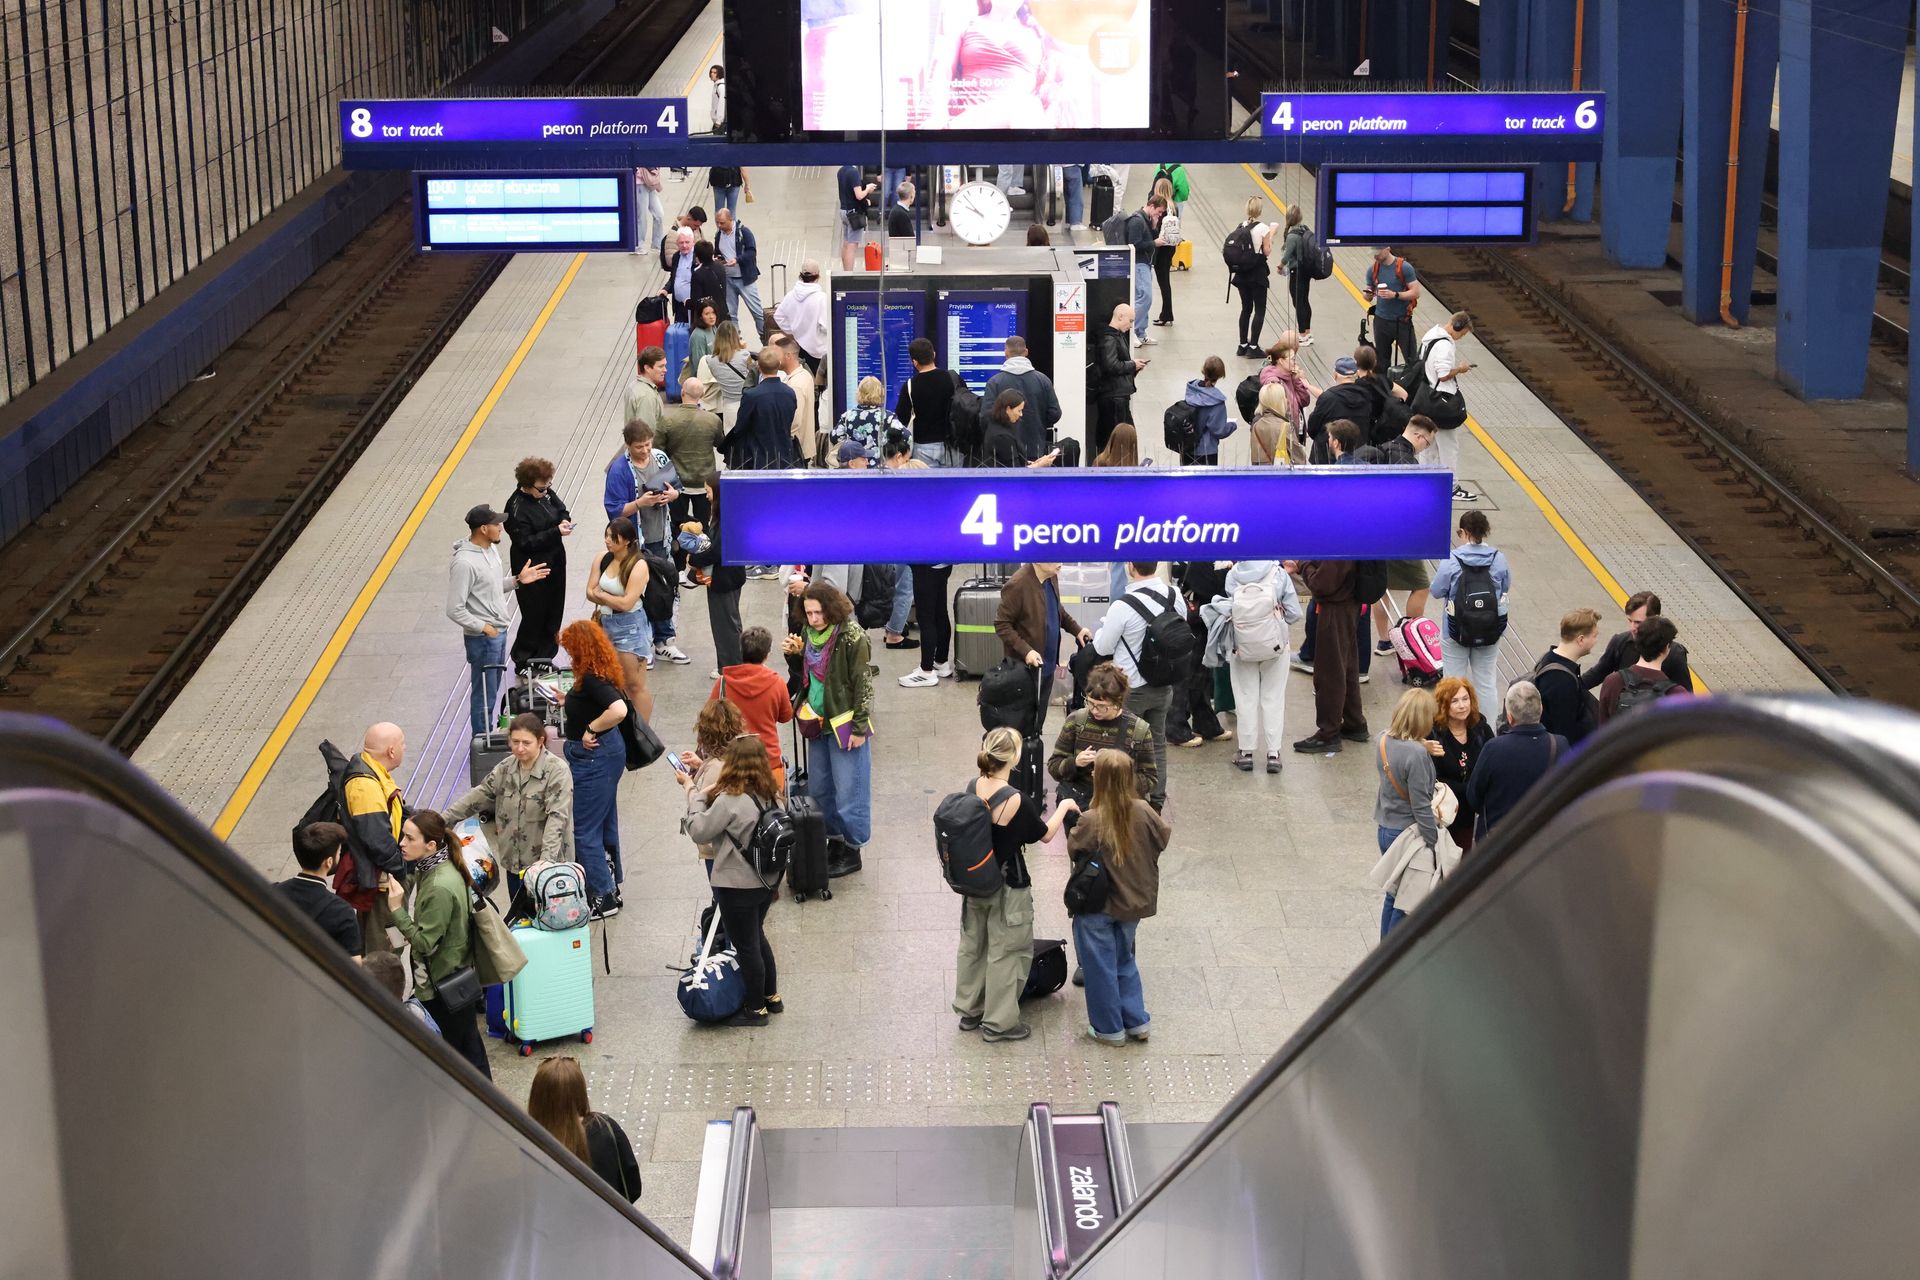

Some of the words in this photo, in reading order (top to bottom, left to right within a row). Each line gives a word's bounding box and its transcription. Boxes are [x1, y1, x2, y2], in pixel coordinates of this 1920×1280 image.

[351, 108, 373, 138] 8
[382, 124, 403, 137] tor
[409, 122, 444, 137] track
[543, 124, 584, 138] peron
[590, 121, 648, 138] platform
[656, 105, 679, 134] 4
[1271, 101, 1295, 131] 4
[1302, 119, 1343, 134] peron
[1348, 116, 1407, 134] platform
[1505, 117, 1526, 129] tor
[1531, 115, 1566, 129] track
[1574, 99, 1597, 129] 6
[960, 494, 1003, 546] 4
[1013, 522, 1100, 551] peron
[1114, 515, 1240, 550] platform
[1069, 1166, 1104, 1230] zalando
